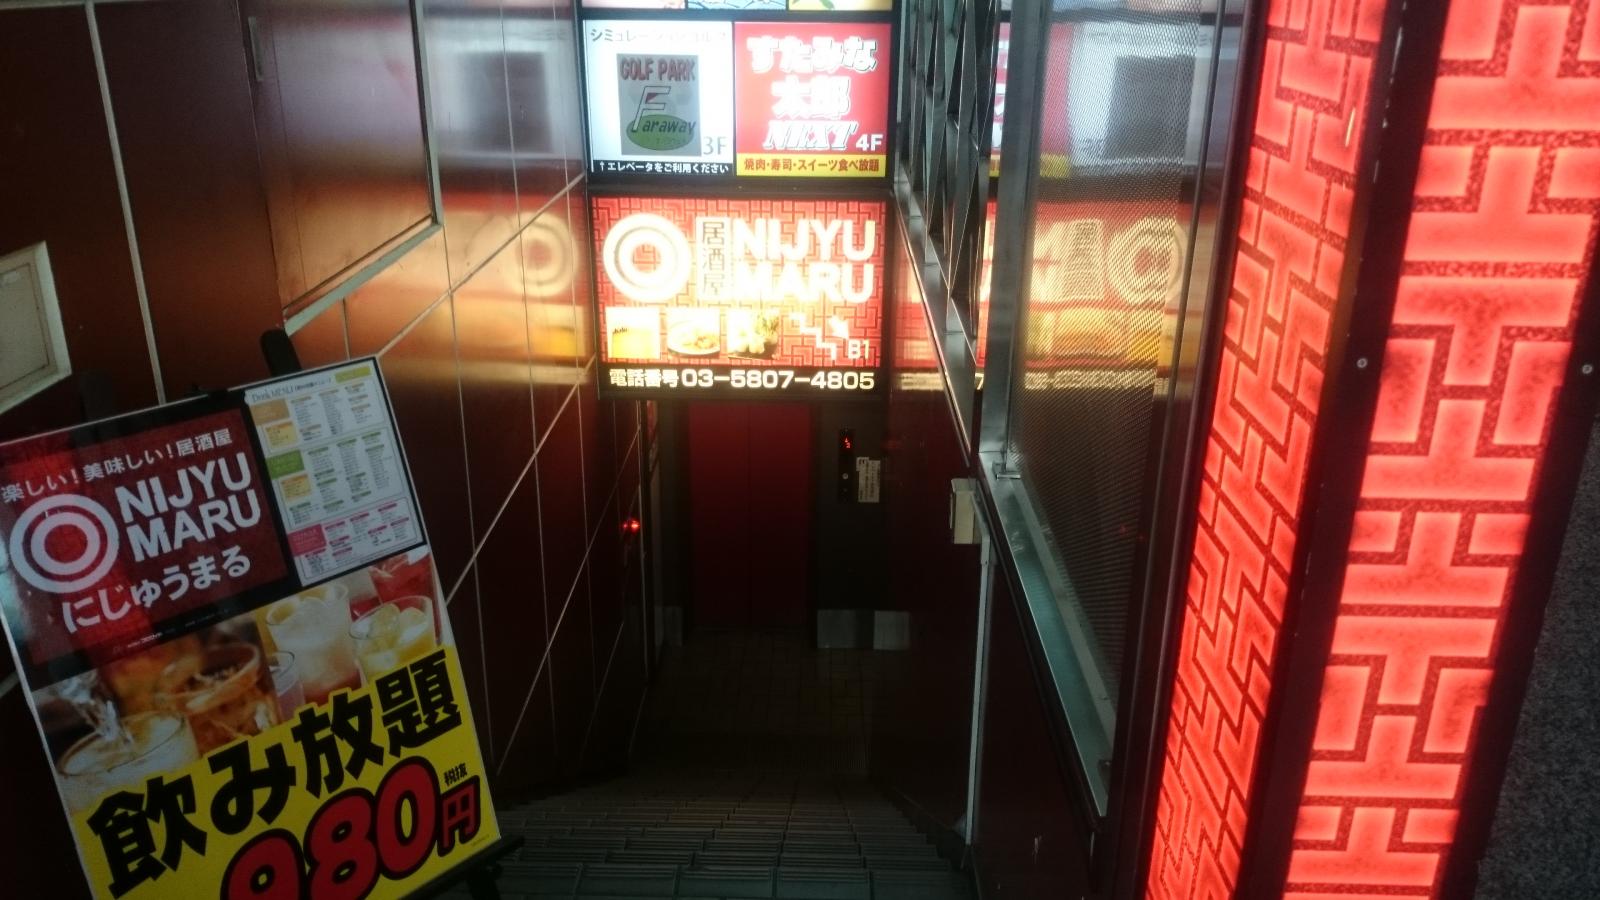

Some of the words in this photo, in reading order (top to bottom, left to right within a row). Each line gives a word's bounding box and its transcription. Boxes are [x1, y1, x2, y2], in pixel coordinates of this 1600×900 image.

[620, 58, 653, 81] GOLF
[658, 58, 696, 82] PARK
[747, 36, 878, 73] すたみな
[771, 76, 850, 120] 太郎
[703, 136, 729, 156] 3F
[763, 121, 859, 151] NEXT
[856, 134, 883, 151] 4F
[606, 161, 729, 174] エレベータをご利用ください
[702, 221, 725, 296] 居酒屋
[731, 218, 876, 262] NIJYU
[733, 262, 875, 304] MARU
[848, 340, 870, 359] B1
[609, 368, 679, 388] 電話番号
[681, 368, 875, 391] 03-5807-4805
[114, 451, 253, 524] NIJYU
[126, 489, 262, 563] MARU
[62, 545, 252, 633] にじゅうまる
[87, 649, 463, 899] 飲み放題
